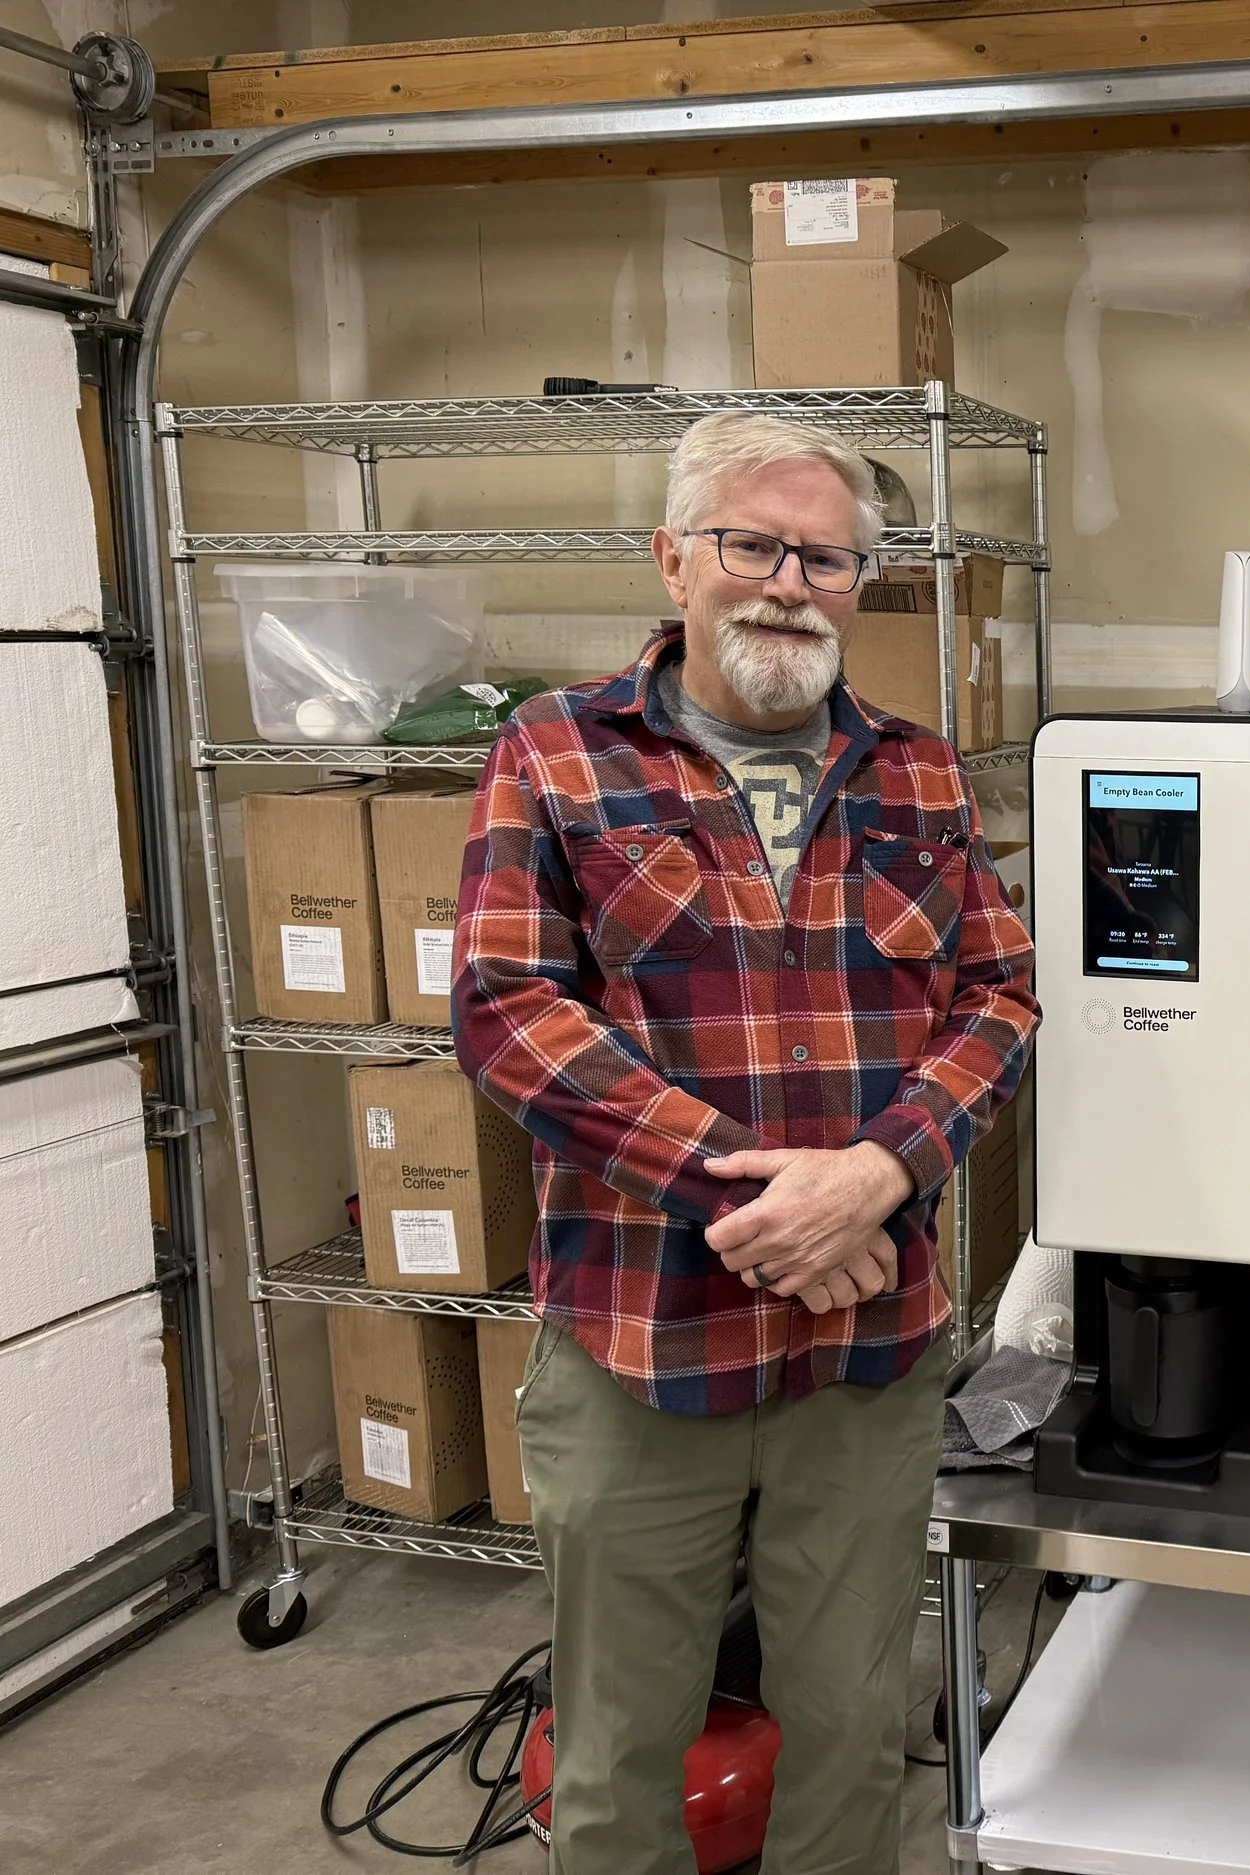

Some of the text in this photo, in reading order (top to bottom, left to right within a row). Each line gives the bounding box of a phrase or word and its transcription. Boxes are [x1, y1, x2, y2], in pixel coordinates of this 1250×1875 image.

[1103, 787, 1184, 798] Empty Bean Cooler
[290, 894, 357, 909] Bellwether
[426, 897, 458, 909] Bellw
[291, 906, 333, 920] Coffee
[1123, 1006, 1197, 1020] Bellwether
[1123, 1018, 1169, 1032] Coffee
[401, 1164, 470, 1179] Bellwether
[402, 1177, 445, 1191] Coffee
[365, 1394, 417, 1417] Bellwether
[366, 1406, 399, 1423] Coffee
